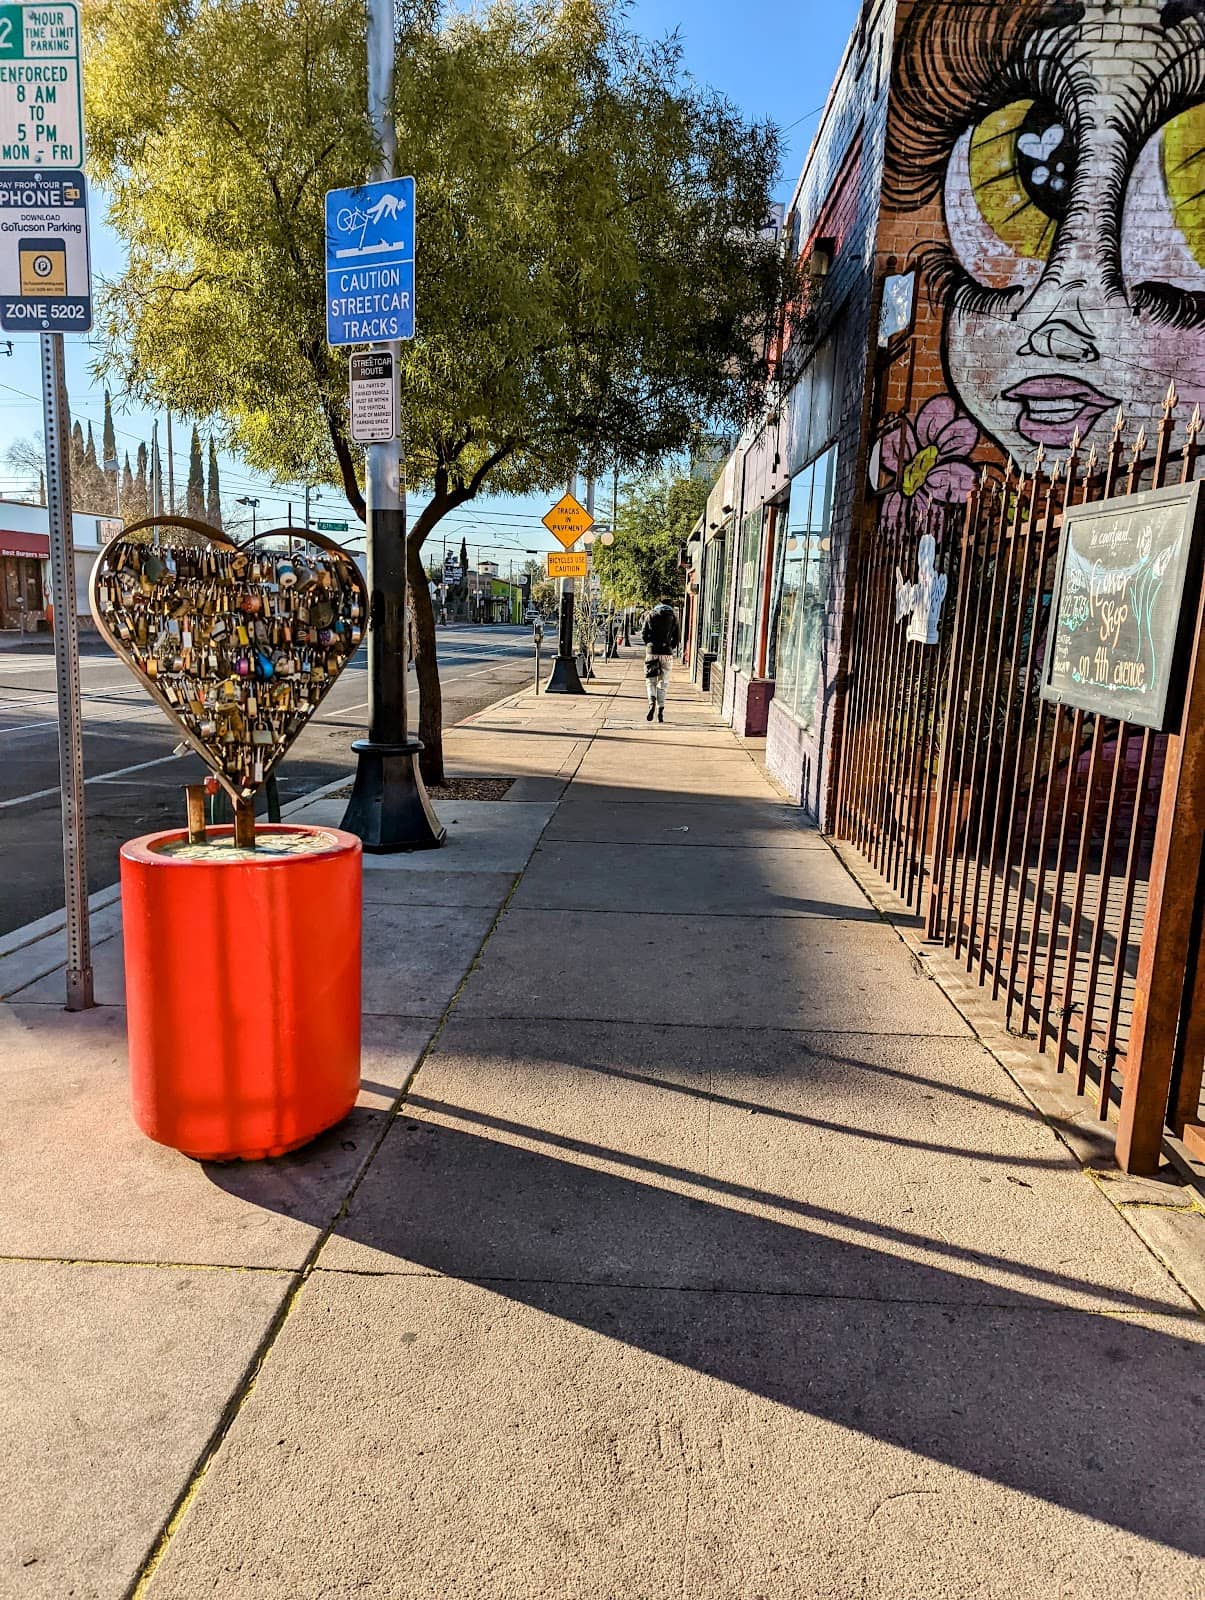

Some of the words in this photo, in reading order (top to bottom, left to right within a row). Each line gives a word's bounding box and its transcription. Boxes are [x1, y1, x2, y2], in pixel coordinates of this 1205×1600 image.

[34, 12, 64, 26] HOUR
[0, 17, 13, 48] 2
[24, 27, 46, 38] TIME
[50, 27, 74, 38] LIMIT
[31, 40, 69, 51] PARKING
[1, 67, 68, 82] ENFORCED
[17, 85, 26, 102] 8
[35, 86, 57, 103] AM
[29, 105, 44, 121] TO
[18, 124, 27, 141] 5
[36, 125, 57, 142] PM
[3, 145, 30, 160] MON
[52, 145, 73, 160] FRI
[38, 181, 60, 189] YOUR
[0, 190, 62, 206] PHONE
[1, 222, 45, 232] GoTucson
[47, 222, 82, 234] Parking
[340, 268, 400, 292] CAUTION
[6, 304, 47, 318] ZONE
[51, 304, 85, 319] 5202
[331, 292, 410, 317] STREETCAR
[343, 317, 398, 339] TRACKS
[352, 357, 392, 368] STREETCAR
[360, 367, 384, 376] ROUTE
[557, 507, 580, 515] TRACKS
[549, 556, 574, 564] BICYCLES
[575, 556, 585, 564] USE
[1079, 655, 1090, 679] on
[1094, 646, 1109, 683] 4th
[1114, 659, 1146, 686] avenue
